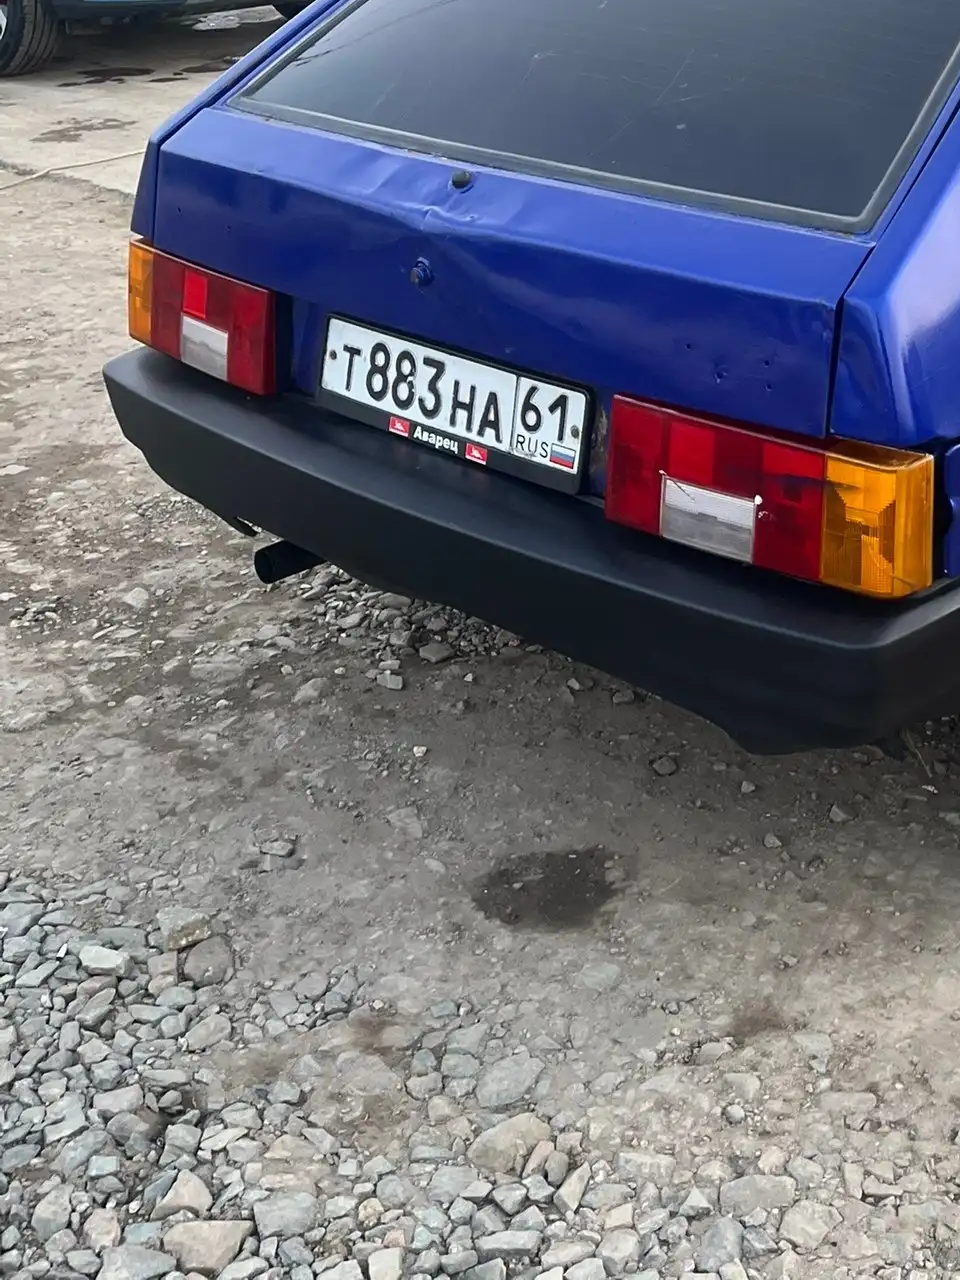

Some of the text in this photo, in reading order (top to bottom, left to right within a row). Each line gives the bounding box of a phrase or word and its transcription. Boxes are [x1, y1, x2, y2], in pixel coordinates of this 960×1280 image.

[342, 342, 568, 444] Т883НА 61
[412, 424, 459, 455] Аварец
[515, 433, 549, 458] RUS
